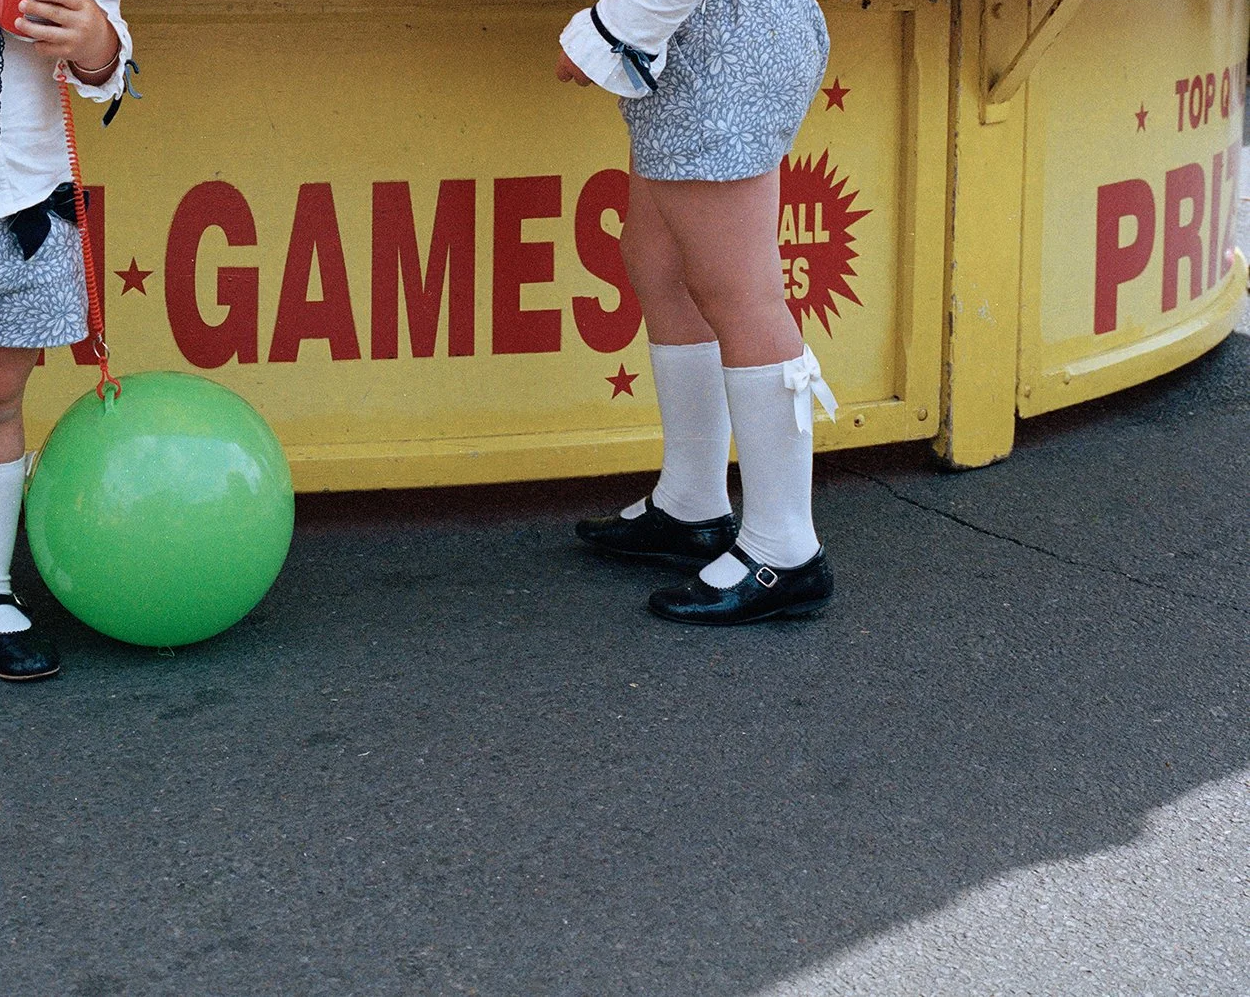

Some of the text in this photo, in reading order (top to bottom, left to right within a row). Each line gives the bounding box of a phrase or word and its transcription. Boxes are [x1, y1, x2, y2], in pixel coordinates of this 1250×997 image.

[1175, 73, 1215, 132] TOP
[778, 203, 830, 245] ALL
[165, 169, 643, 369] GAMES
